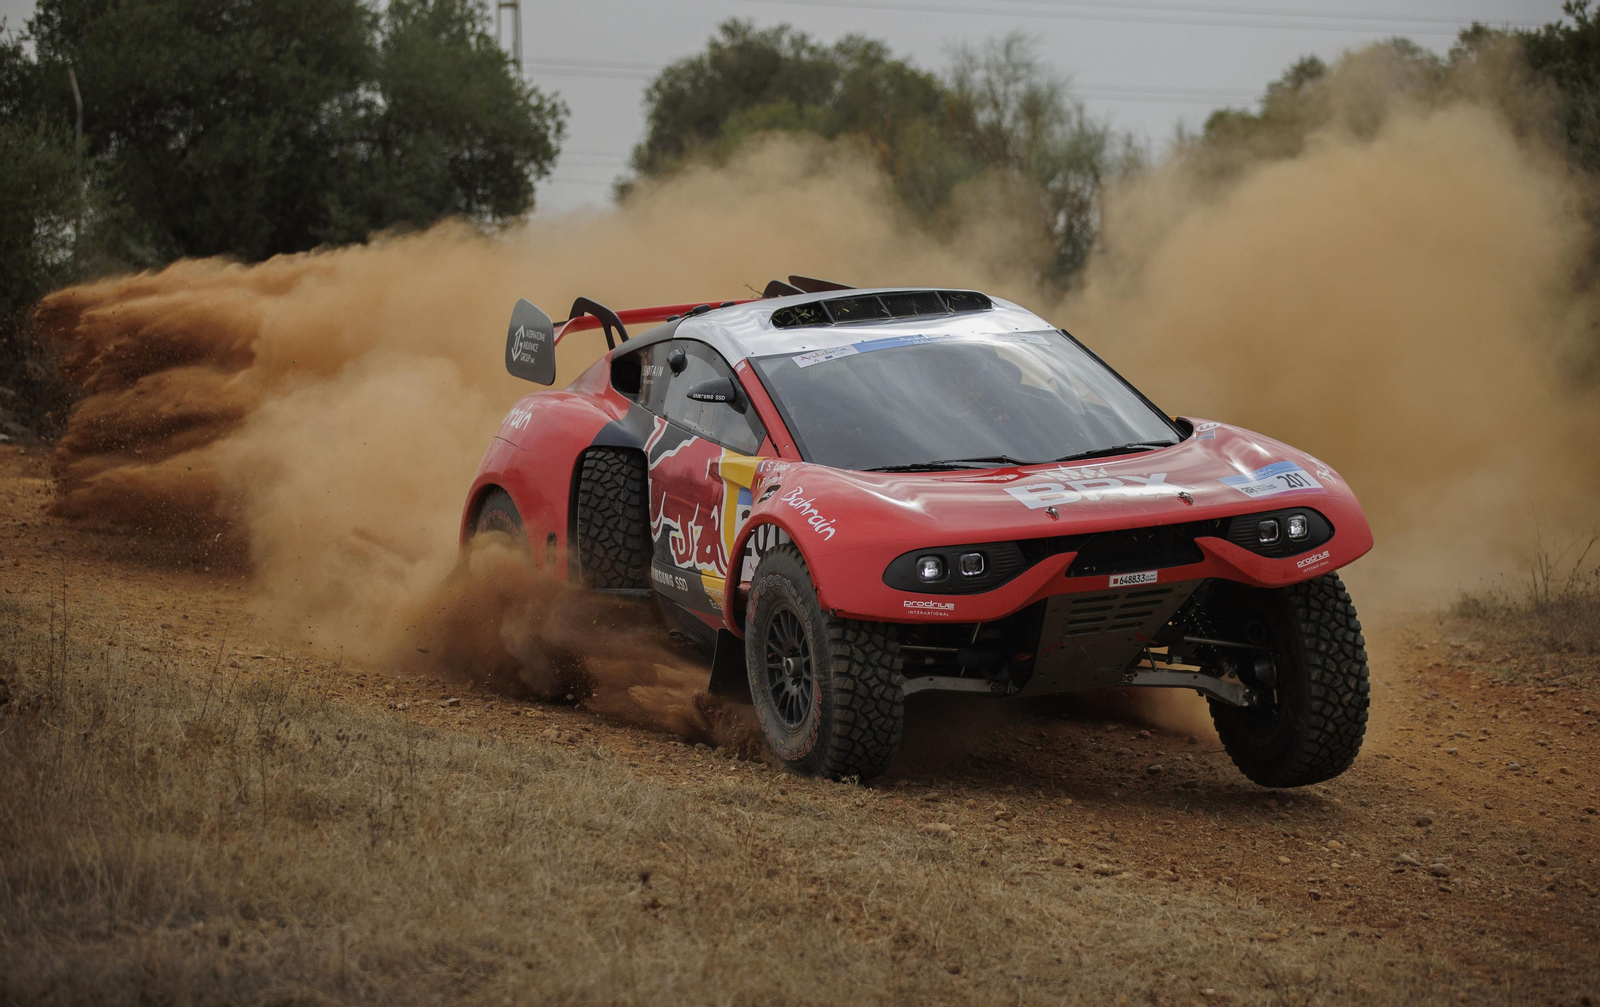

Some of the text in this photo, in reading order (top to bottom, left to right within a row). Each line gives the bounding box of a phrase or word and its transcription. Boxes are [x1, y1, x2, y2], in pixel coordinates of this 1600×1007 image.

[1276, 472, 1312, 489] 201
[781, 486, 836, 541] Bahrain
[675, 575, 689, 592] SSD
[1120, 574, 1146, 585] 648833
